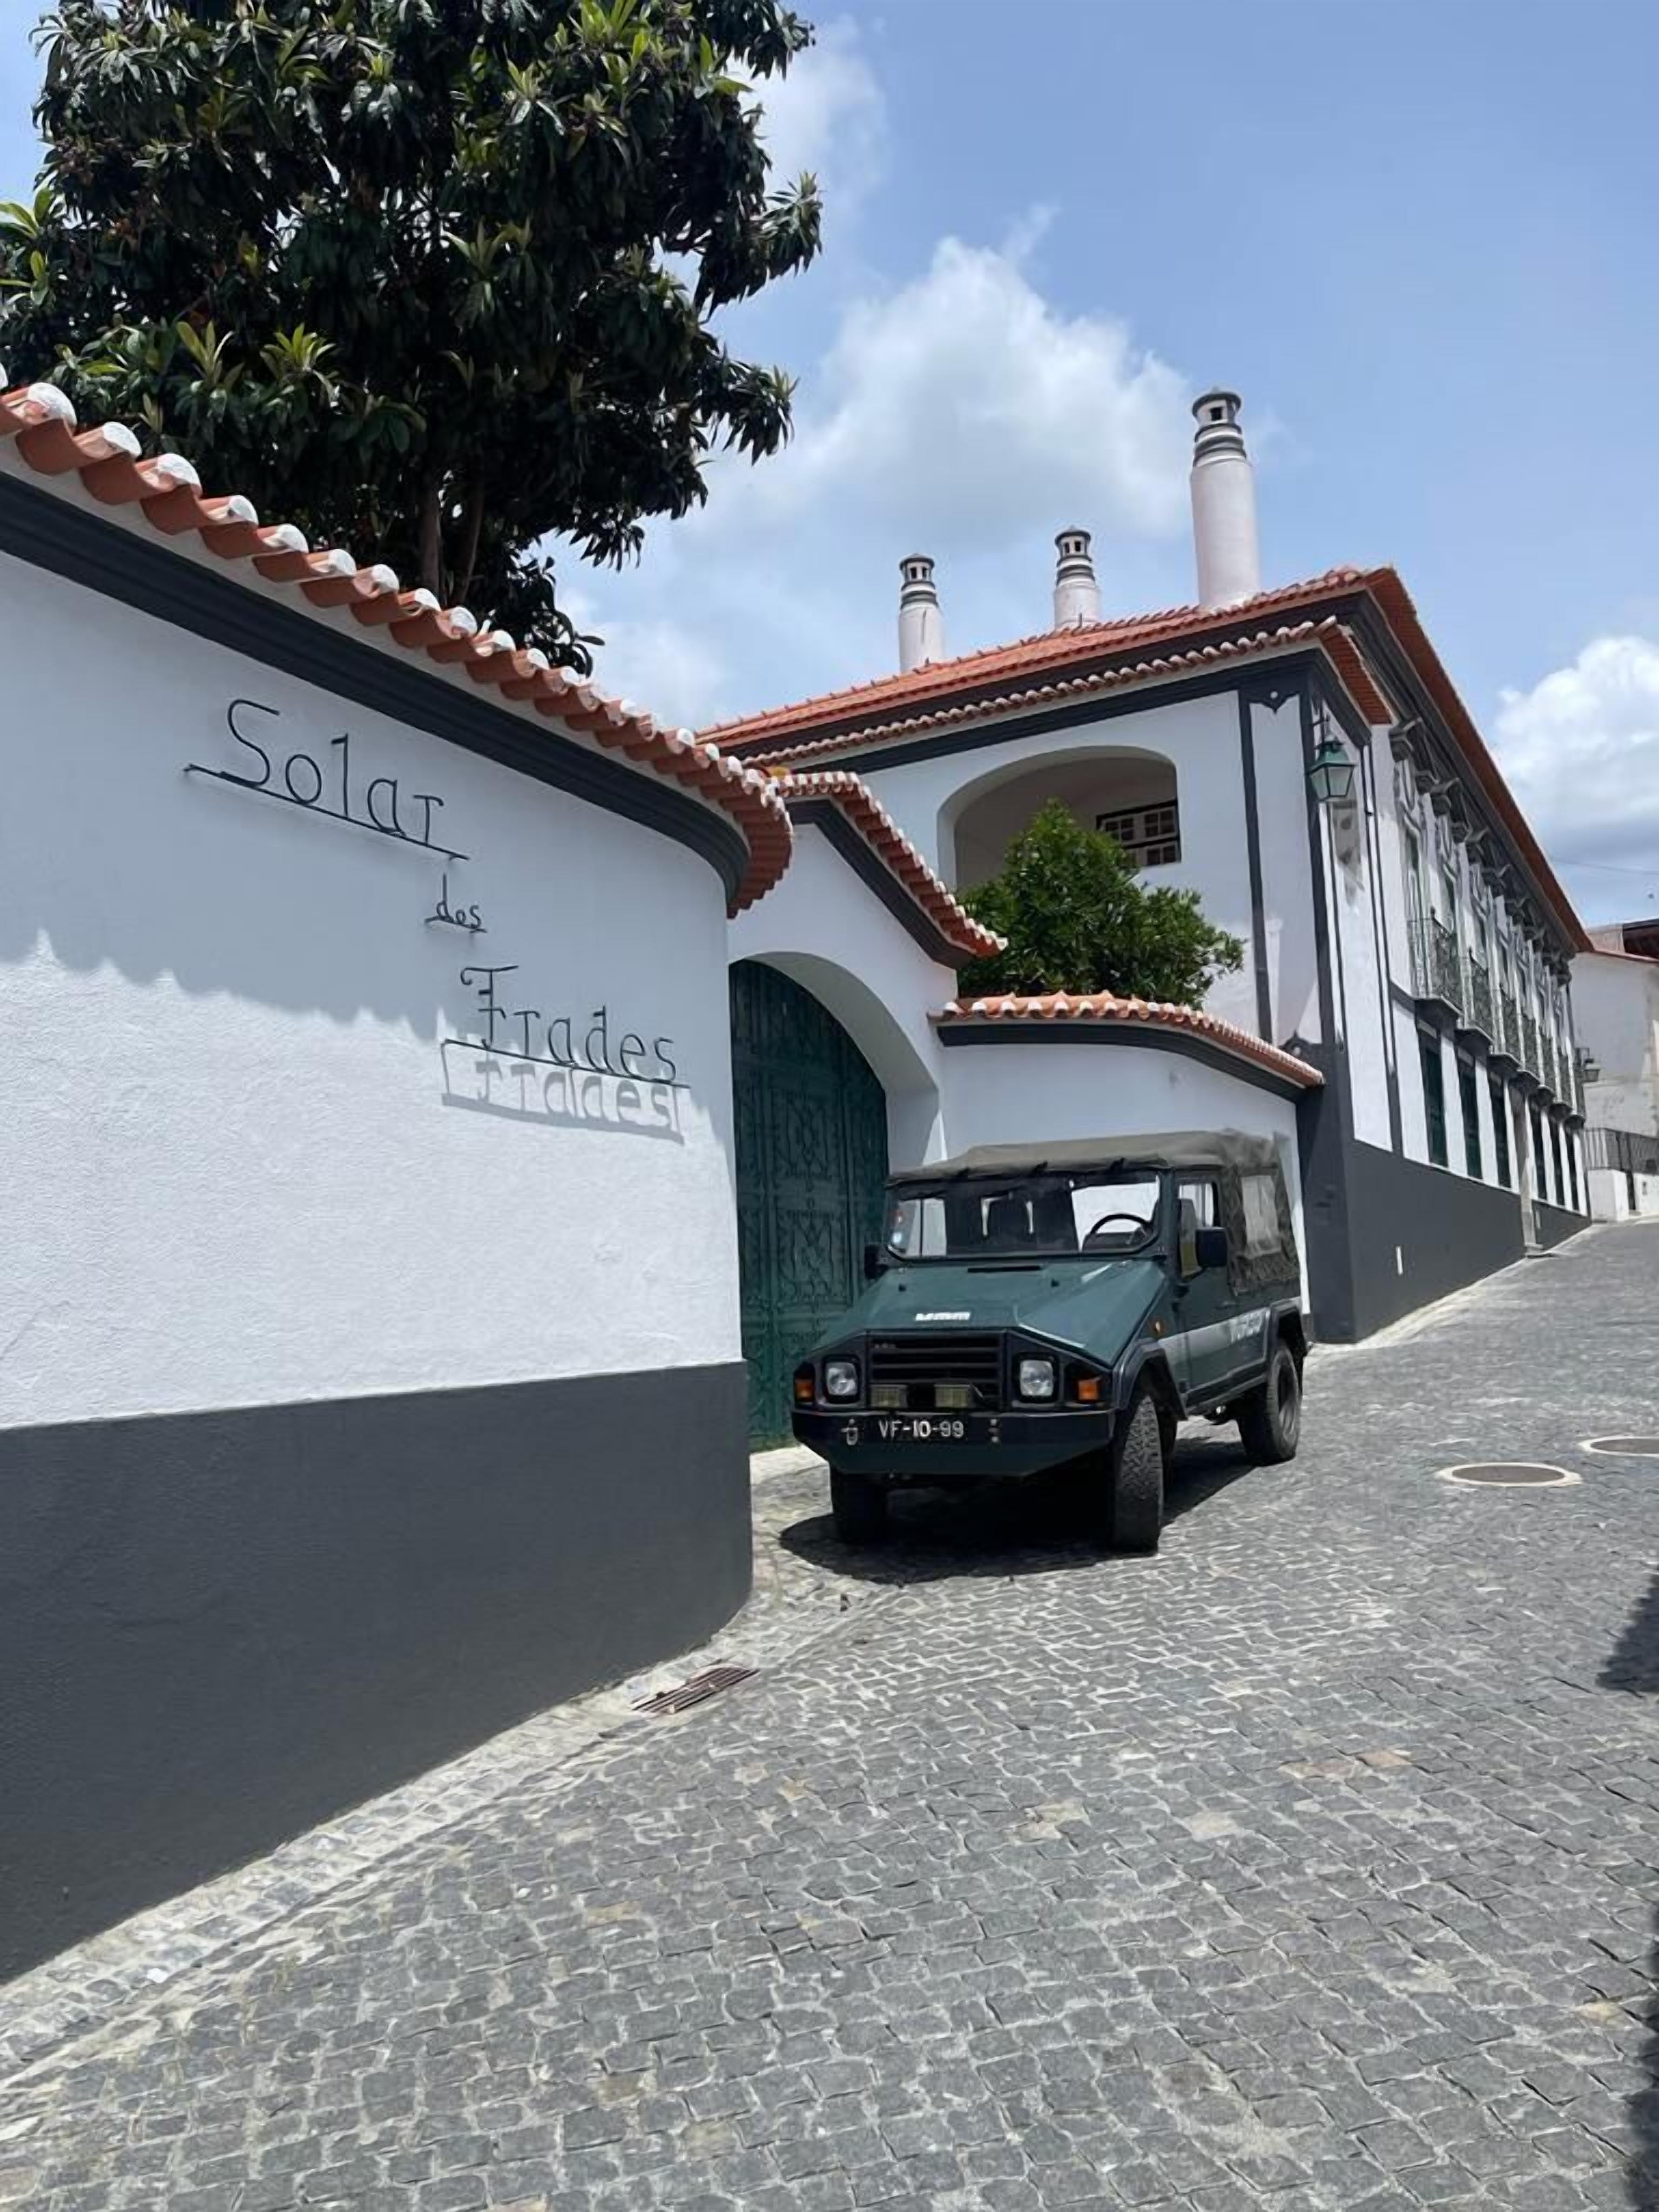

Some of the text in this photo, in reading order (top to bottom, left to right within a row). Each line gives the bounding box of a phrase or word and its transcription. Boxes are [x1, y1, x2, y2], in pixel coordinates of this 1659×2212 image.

[227, 698, 444, 846] Solar
[435, 873, 482, 929] des
[460, 965, 676, 1084] Frades
[879, 1420, 964, 1438] VF-10-99
